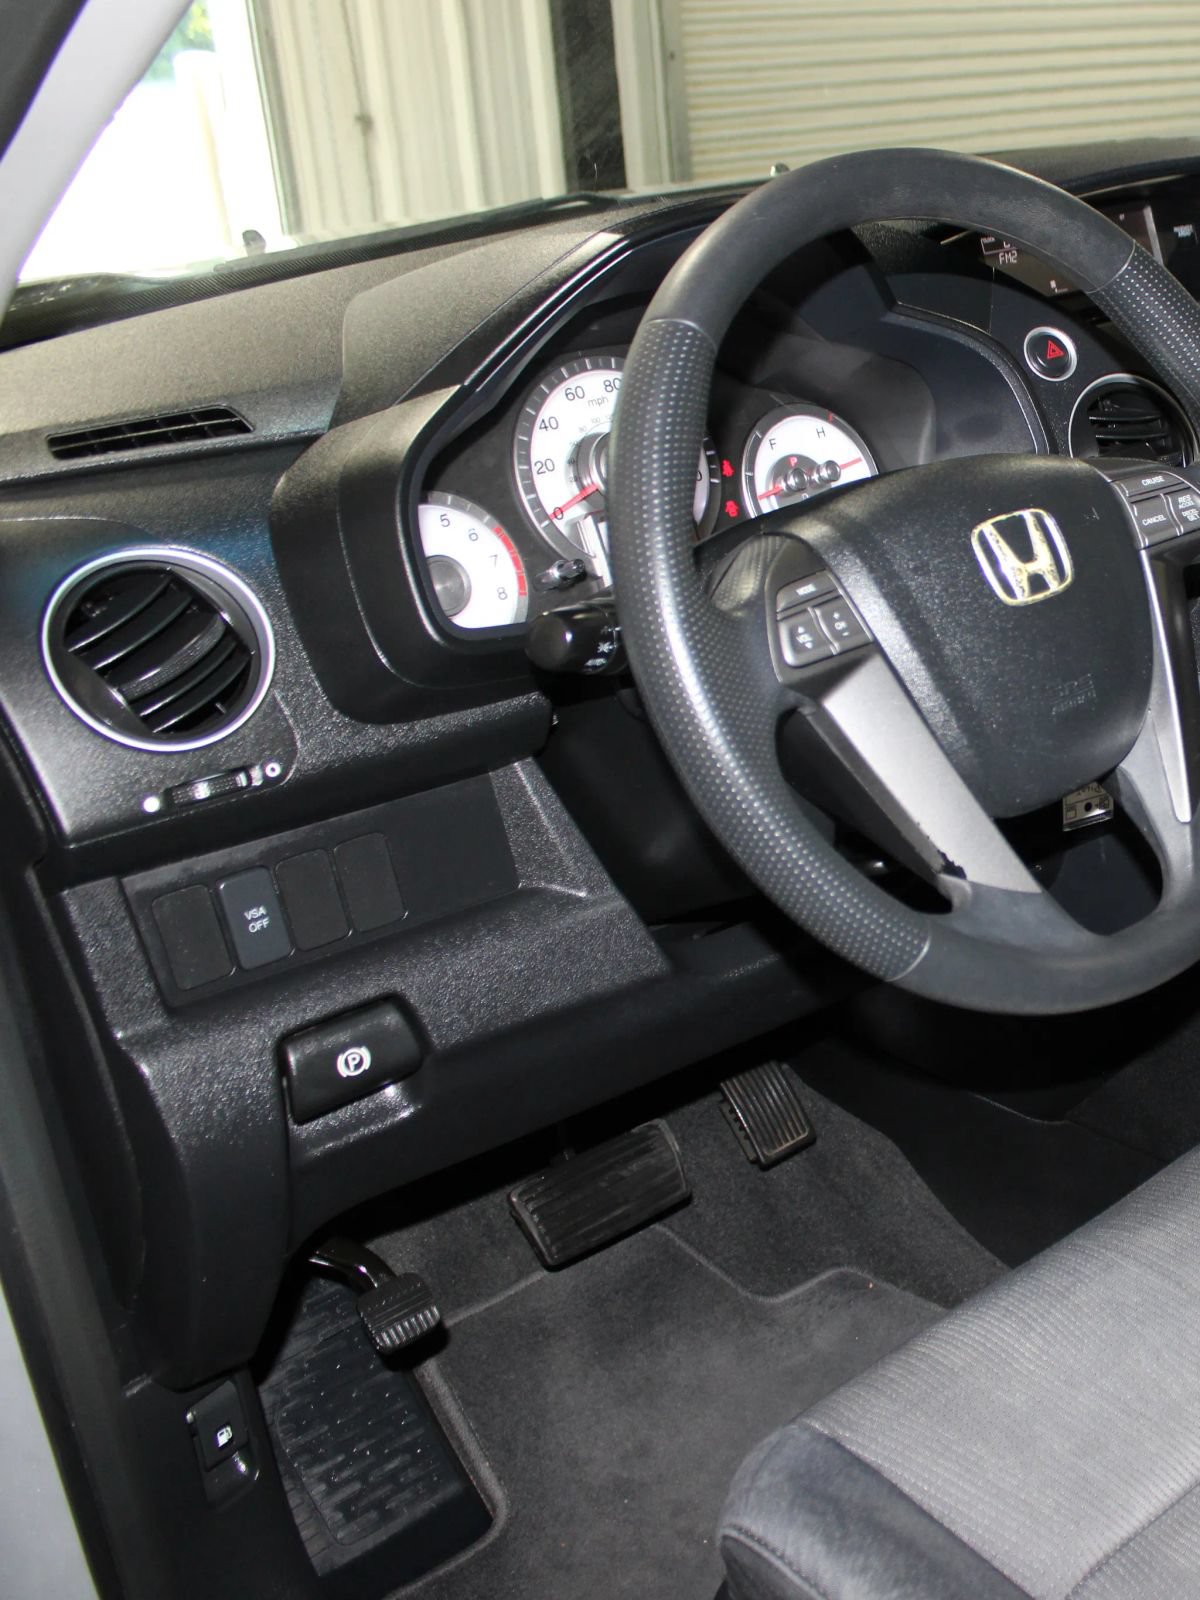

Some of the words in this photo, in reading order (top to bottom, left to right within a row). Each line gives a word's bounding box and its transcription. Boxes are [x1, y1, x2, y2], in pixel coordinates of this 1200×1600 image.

[998, 250, 1018, 264] FM2
[564, 385, 585, 402] 60
[587, 395, 609, 408] mph
[538, 416, 559, 432] 40
[815, 427, 826, 438] H
[768, 438, 776, 450] F
[534, 458, 556, 475] 20
[788, 456, 798, 467] P
[1141, 475, 1165, 486] CRUISE
[439, 513, 451, 527] 5
[552, 506, 564, 520] 0
[1142, 514, 1167, 526] CANCEL
[468, 528, 479, 542] 6
[489, 554, 499, 568] 7
[496, 587, 508, 600] 8
[244, 905, 267, 921] VSA
[248, 917, 272, 933] OFF
